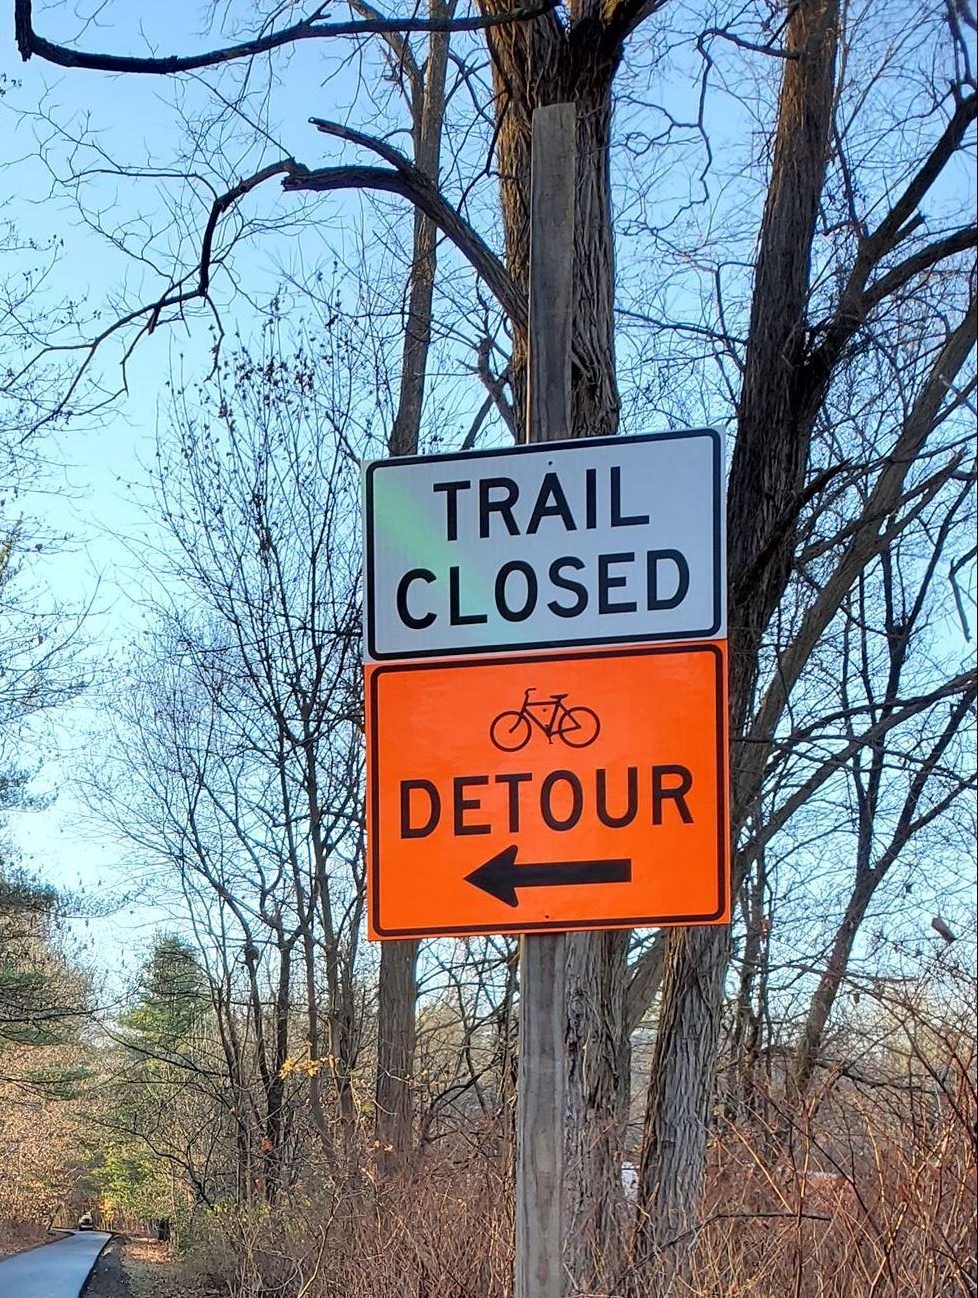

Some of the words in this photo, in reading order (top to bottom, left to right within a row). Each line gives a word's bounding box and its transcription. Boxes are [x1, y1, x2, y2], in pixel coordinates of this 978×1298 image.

[433, 466, 650, 541] TRAIL
[396, 548, 690, 630] CLOSED
[400, 764, 694, 839] DETOUR
